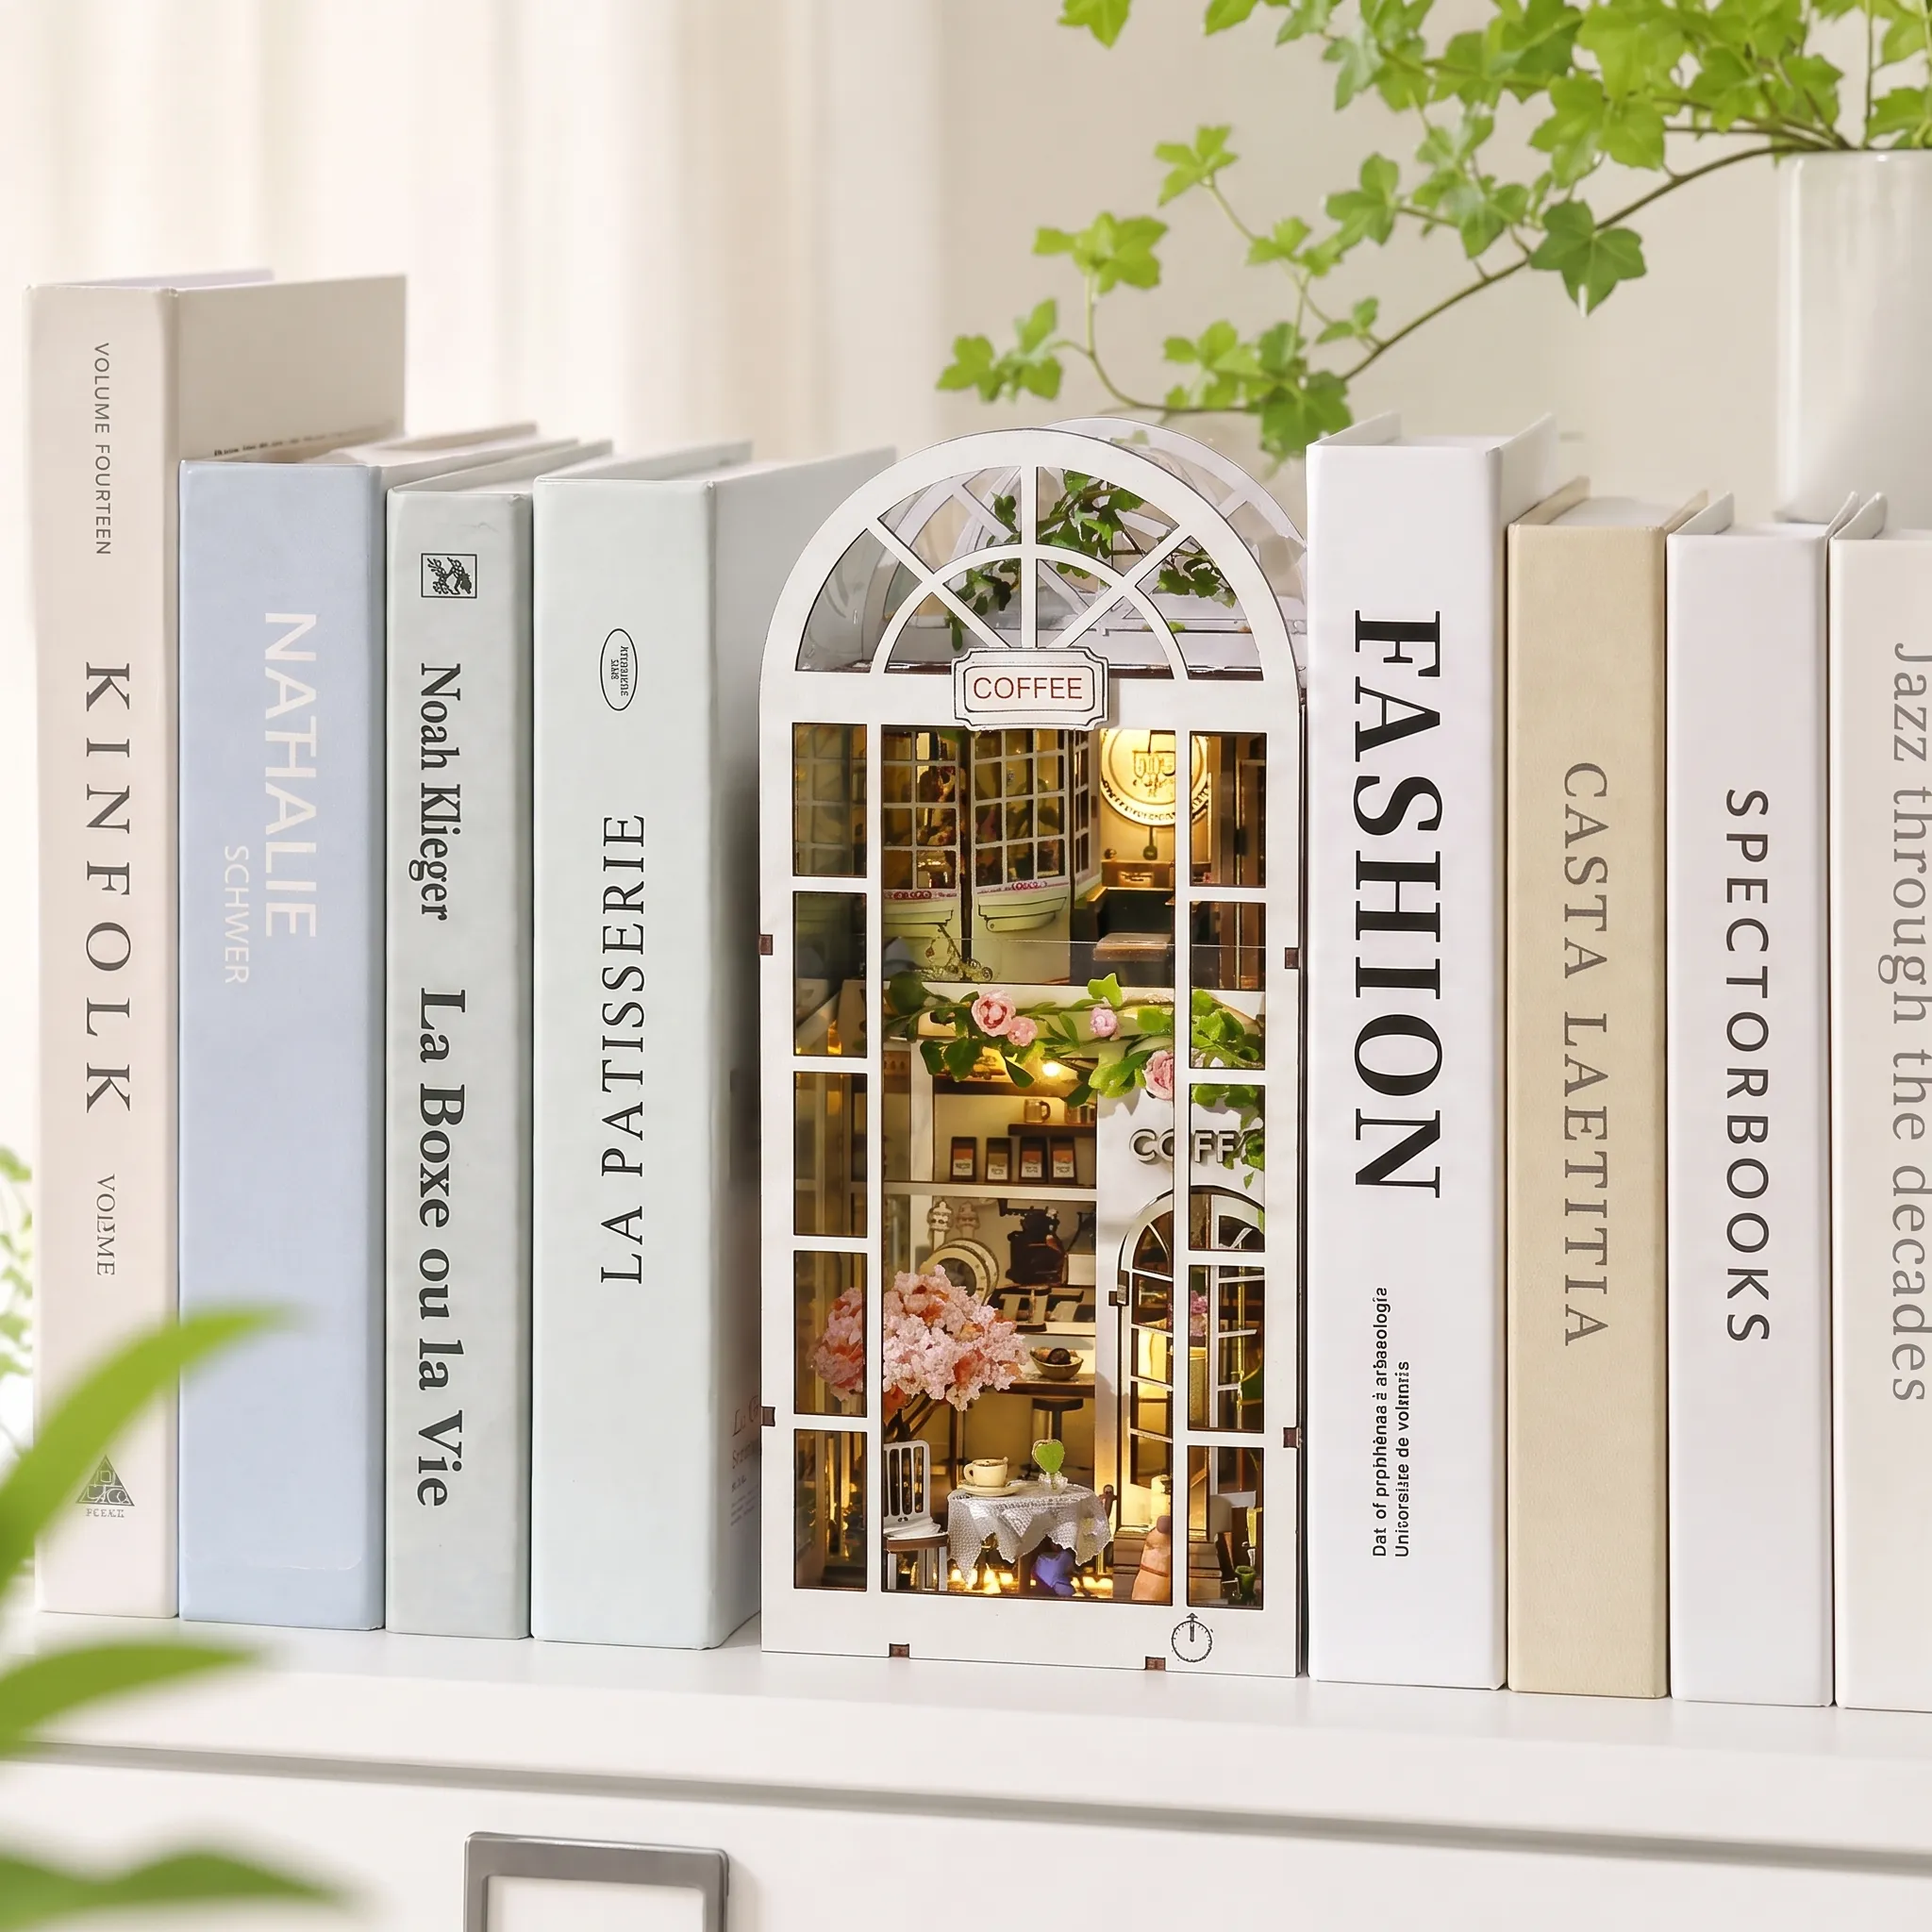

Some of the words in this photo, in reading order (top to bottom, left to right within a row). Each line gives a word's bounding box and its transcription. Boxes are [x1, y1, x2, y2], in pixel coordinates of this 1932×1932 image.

[93, 341, 110, 434] VOLUME
[94, 443, 111, 555] FOURTEEN
[420, 662, 461, 772] Noah
[973, 676, 1083, 700] COFFEE
[1893, 642, 1932, 762] Jazz
[264, 612, 318, 938] NATHALIE
[85, 661, 132, 1114] KINFOLK
[408, 781, 462, 922] Klieger
[1353, 609, 1443, 1199] FASHION
[1563, 761, 1609, 980] CASTA
[1877, 786, 1932, 1024] through
[224, 845, 250, 984] SCHWER
[419, 987, 466, 1064] La
[601, 814, 645, 1178] PATISSERIE
[1725, 789, 1771, 1341] SPECTORBOOKS
[1891, 1048, 1932, 1141] the
[419, 1082, 466, 1228] Boxe
[1563, 1010, 1609, 1347] LAETITIA
[418, 1248, 450, 1321] ou
[600, 1205, 643, 1285] LA
[1891, 1165, 1932, 1401] decades
[418, 1338, 465, 1391] la
[416, 1408, 463, 1507] Vie
[1394, 1437, 1410, 1458] de
[1372, 1502, 1388, 1520] of
